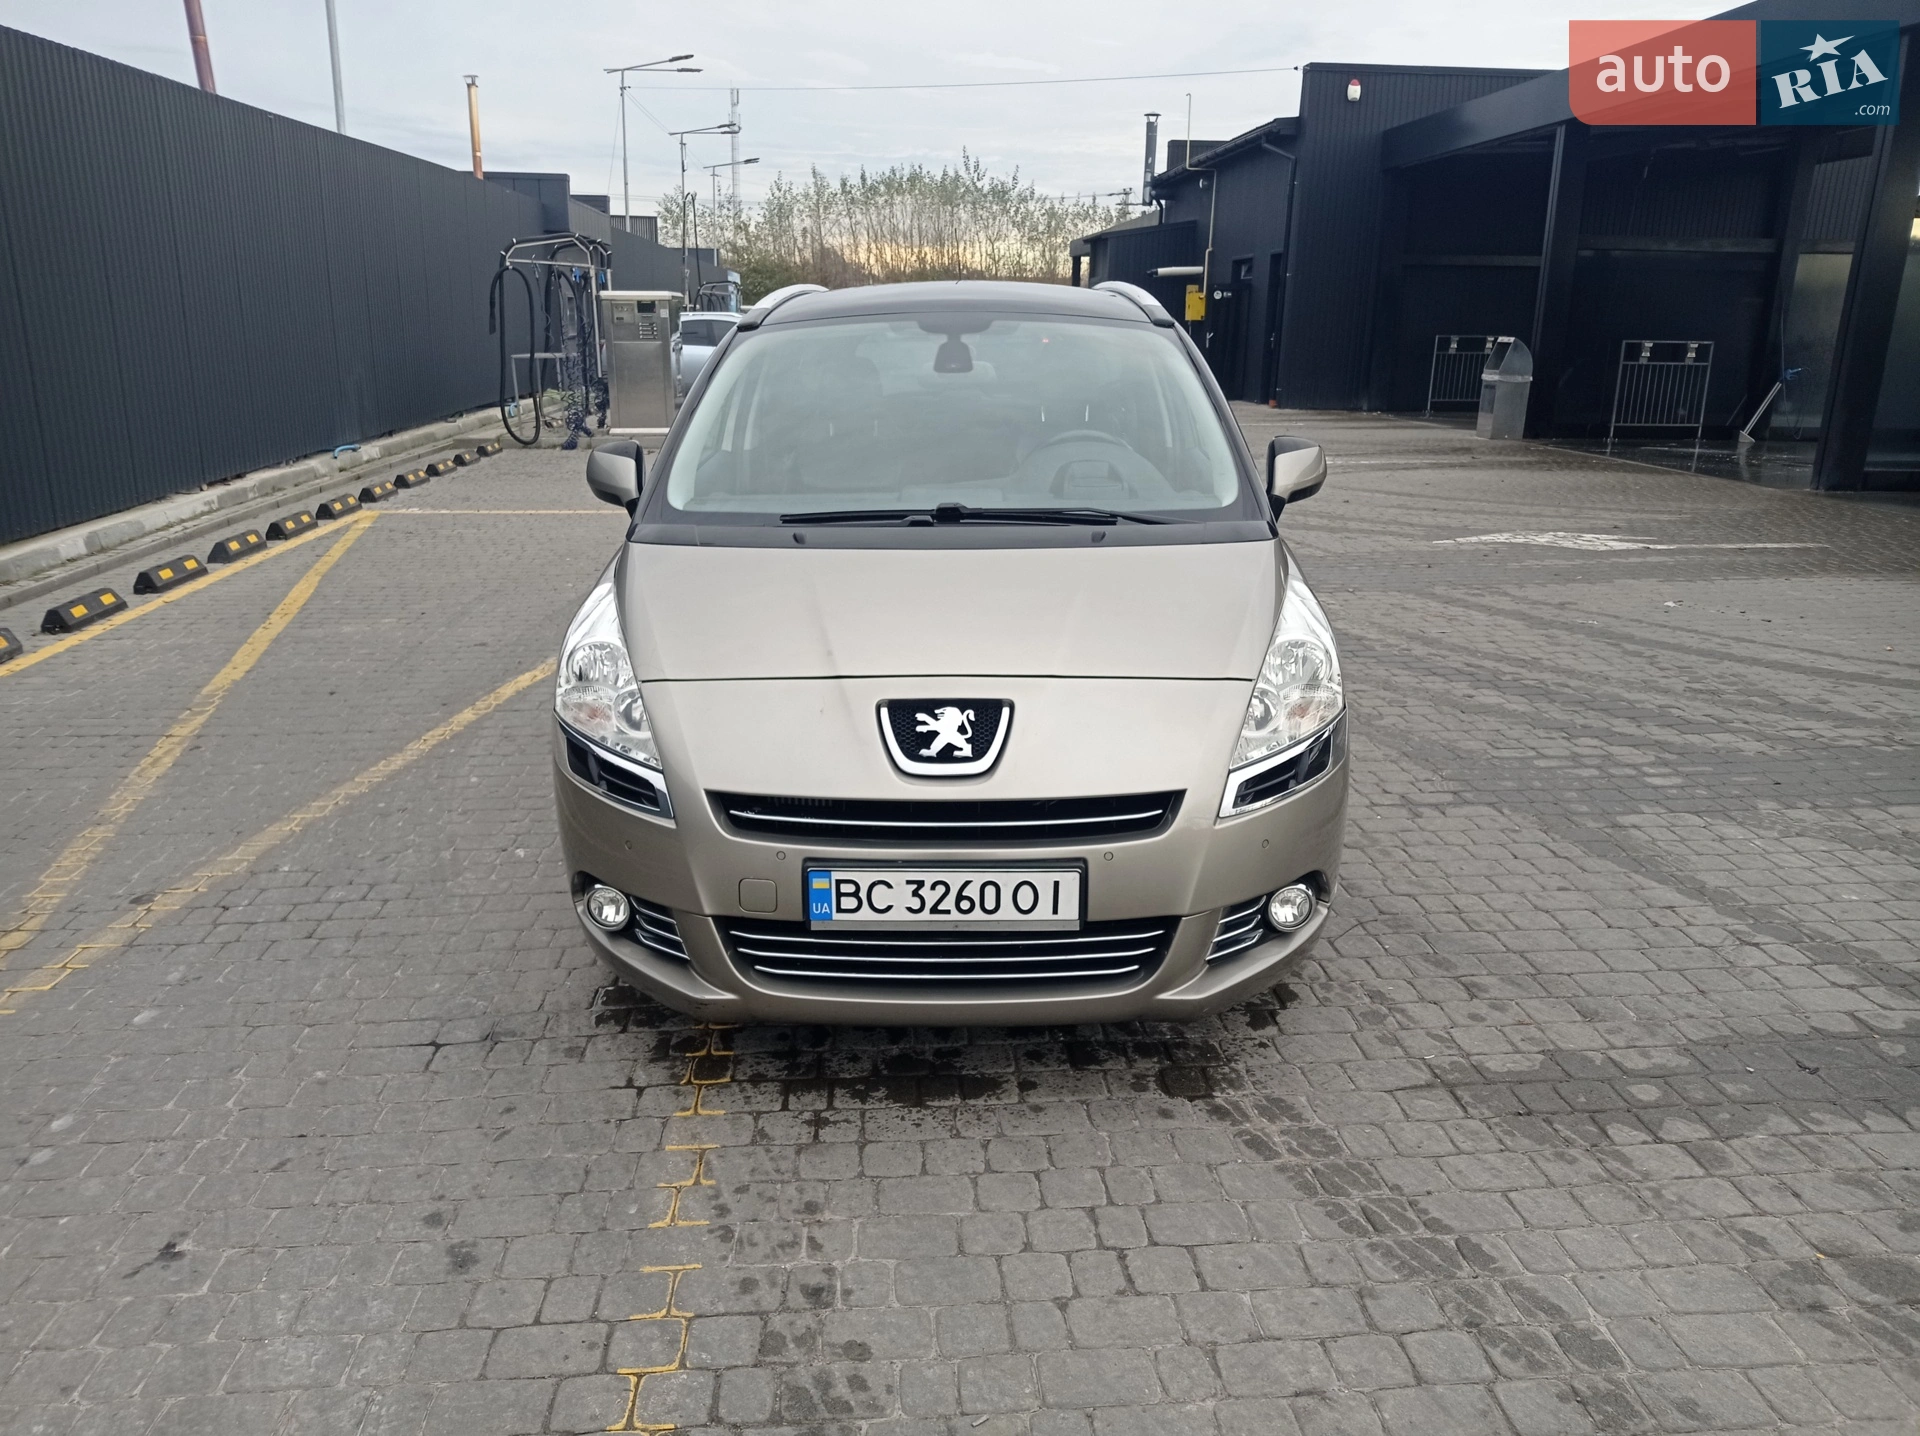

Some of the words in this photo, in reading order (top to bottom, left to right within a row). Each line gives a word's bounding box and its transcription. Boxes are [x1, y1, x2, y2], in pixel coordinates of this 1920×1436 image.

[812, 902, 831, 915] UA
[834, 878, 894, 915] BC
[904, 879, 1002, 915] 3260
